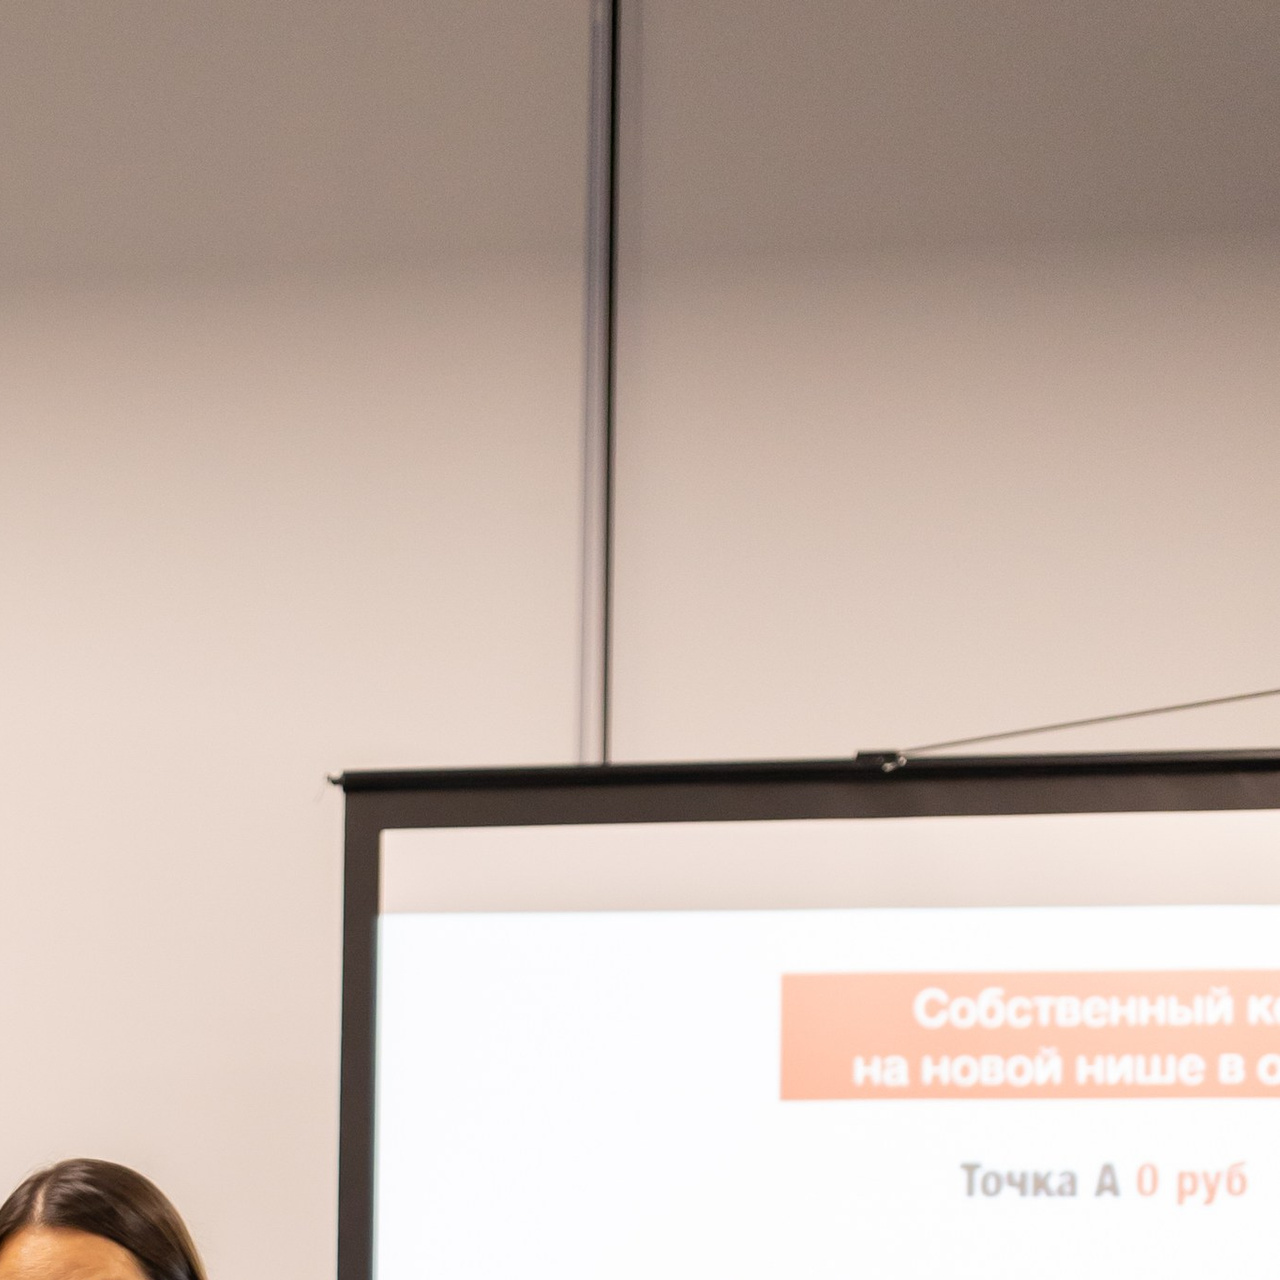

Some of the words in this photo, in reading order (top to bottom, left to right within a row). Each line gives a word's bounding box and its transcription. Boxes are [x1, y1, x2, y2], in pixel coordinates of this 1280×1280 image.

[913, 985, 1235, 1029] Собственный
[1246, 994, 1280, 1026] к
[852, 1054, 910, 1087] на
[920, 1045, 1064, 1087] новой
[1075, 1052, 1207, 1087] нише
[1217, 1052, 1246, 1085] в
[959, 1162, 1078, 1198] Точка
[1094, 1163, 1121, 1197] А
[1136, 1162, 1159, 1197] 0
[1176, 1161, 1249, 1206] руб
